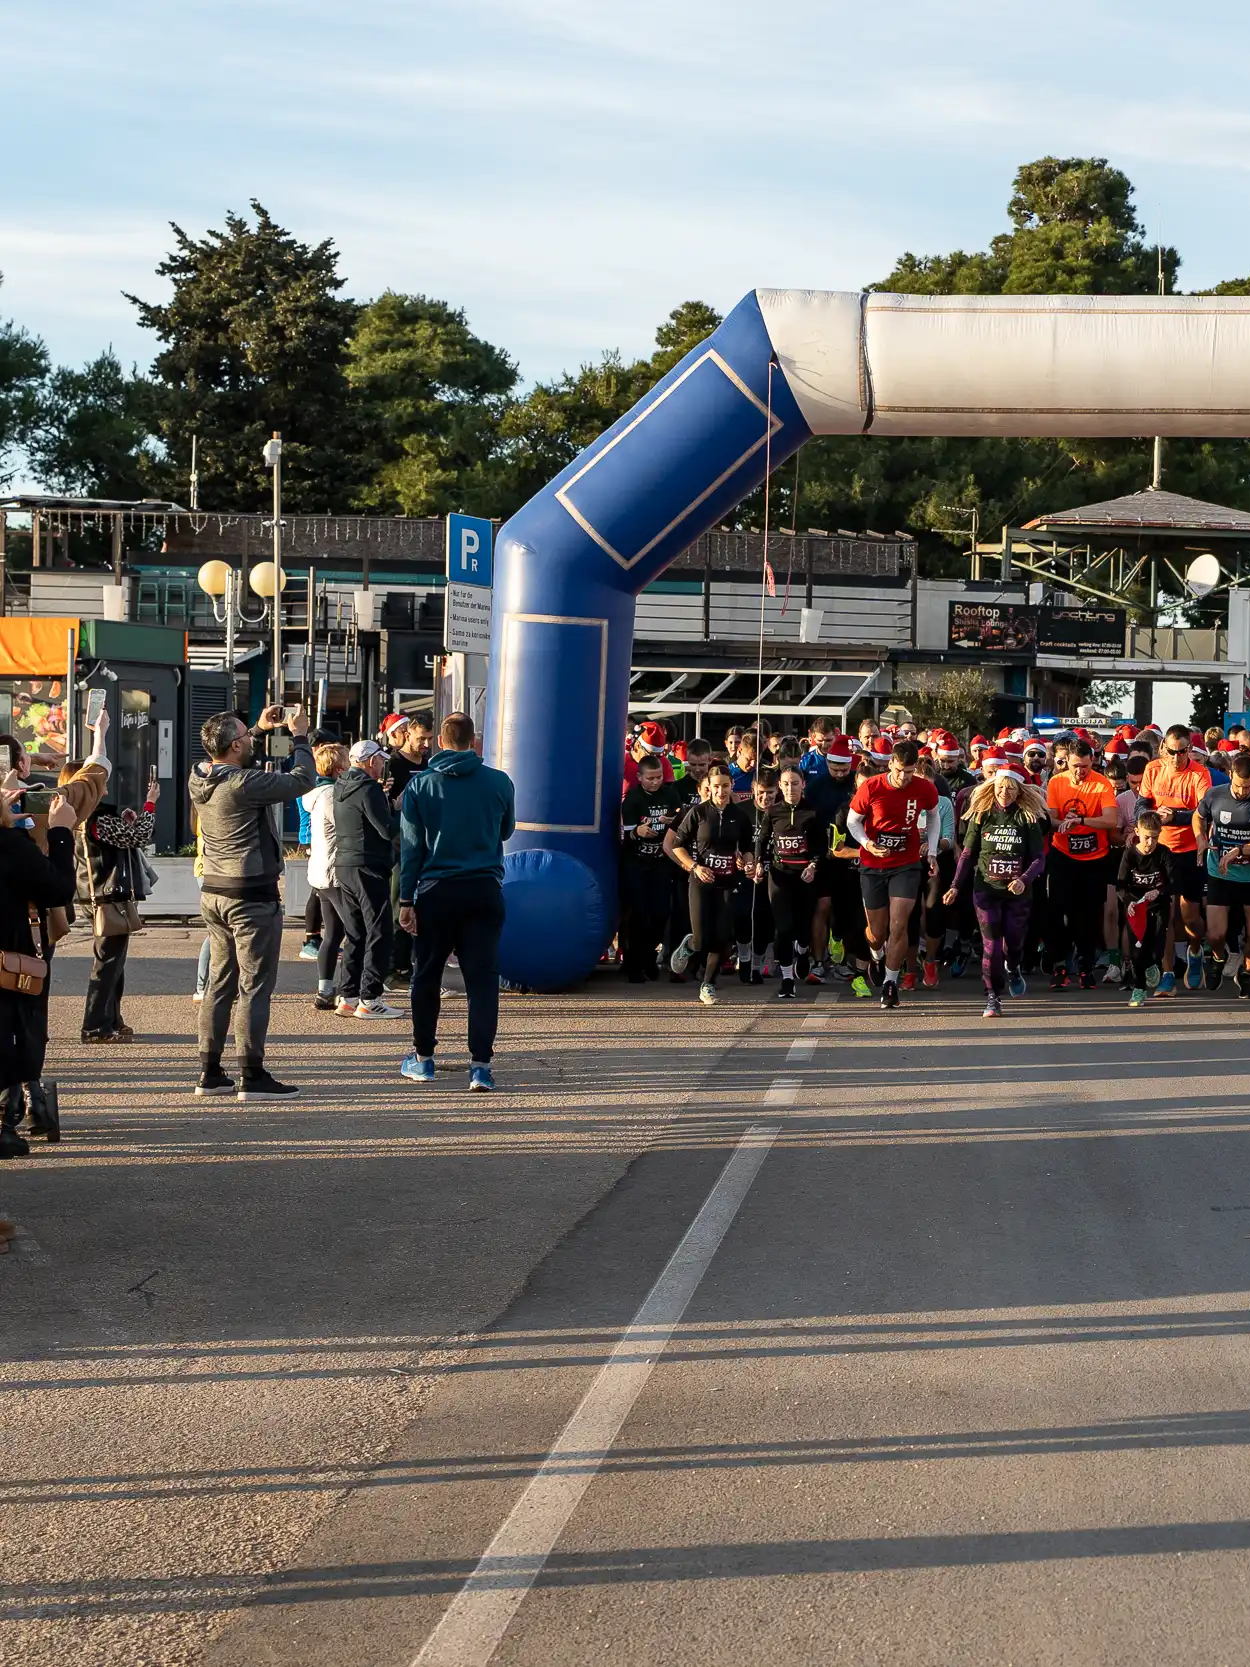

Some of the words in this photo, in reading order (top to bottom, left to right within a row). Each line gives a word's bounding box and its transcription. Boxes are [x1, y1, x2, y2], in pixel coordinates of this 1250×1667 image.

[461, 528, 479, 570] P
[471, 559, 478, 572] R
[954, 604, 1000, 619] Rooftop
[994, 828, 1017, 836] ZADAR
[880, 837, 900, 847] 287
[985, 833, 1022, 843] CHRISTMAS
[640, 844, 659, 854] 237
[780, 839, 799, 849] 196
[995, 843, 1012, 851] RUN
[1071, 840, 1090, 850] 278
[709, 858, 727, 869] 193
[992, 863, 1012, 874] 134
[1135, 876, 1155, 885] 247
